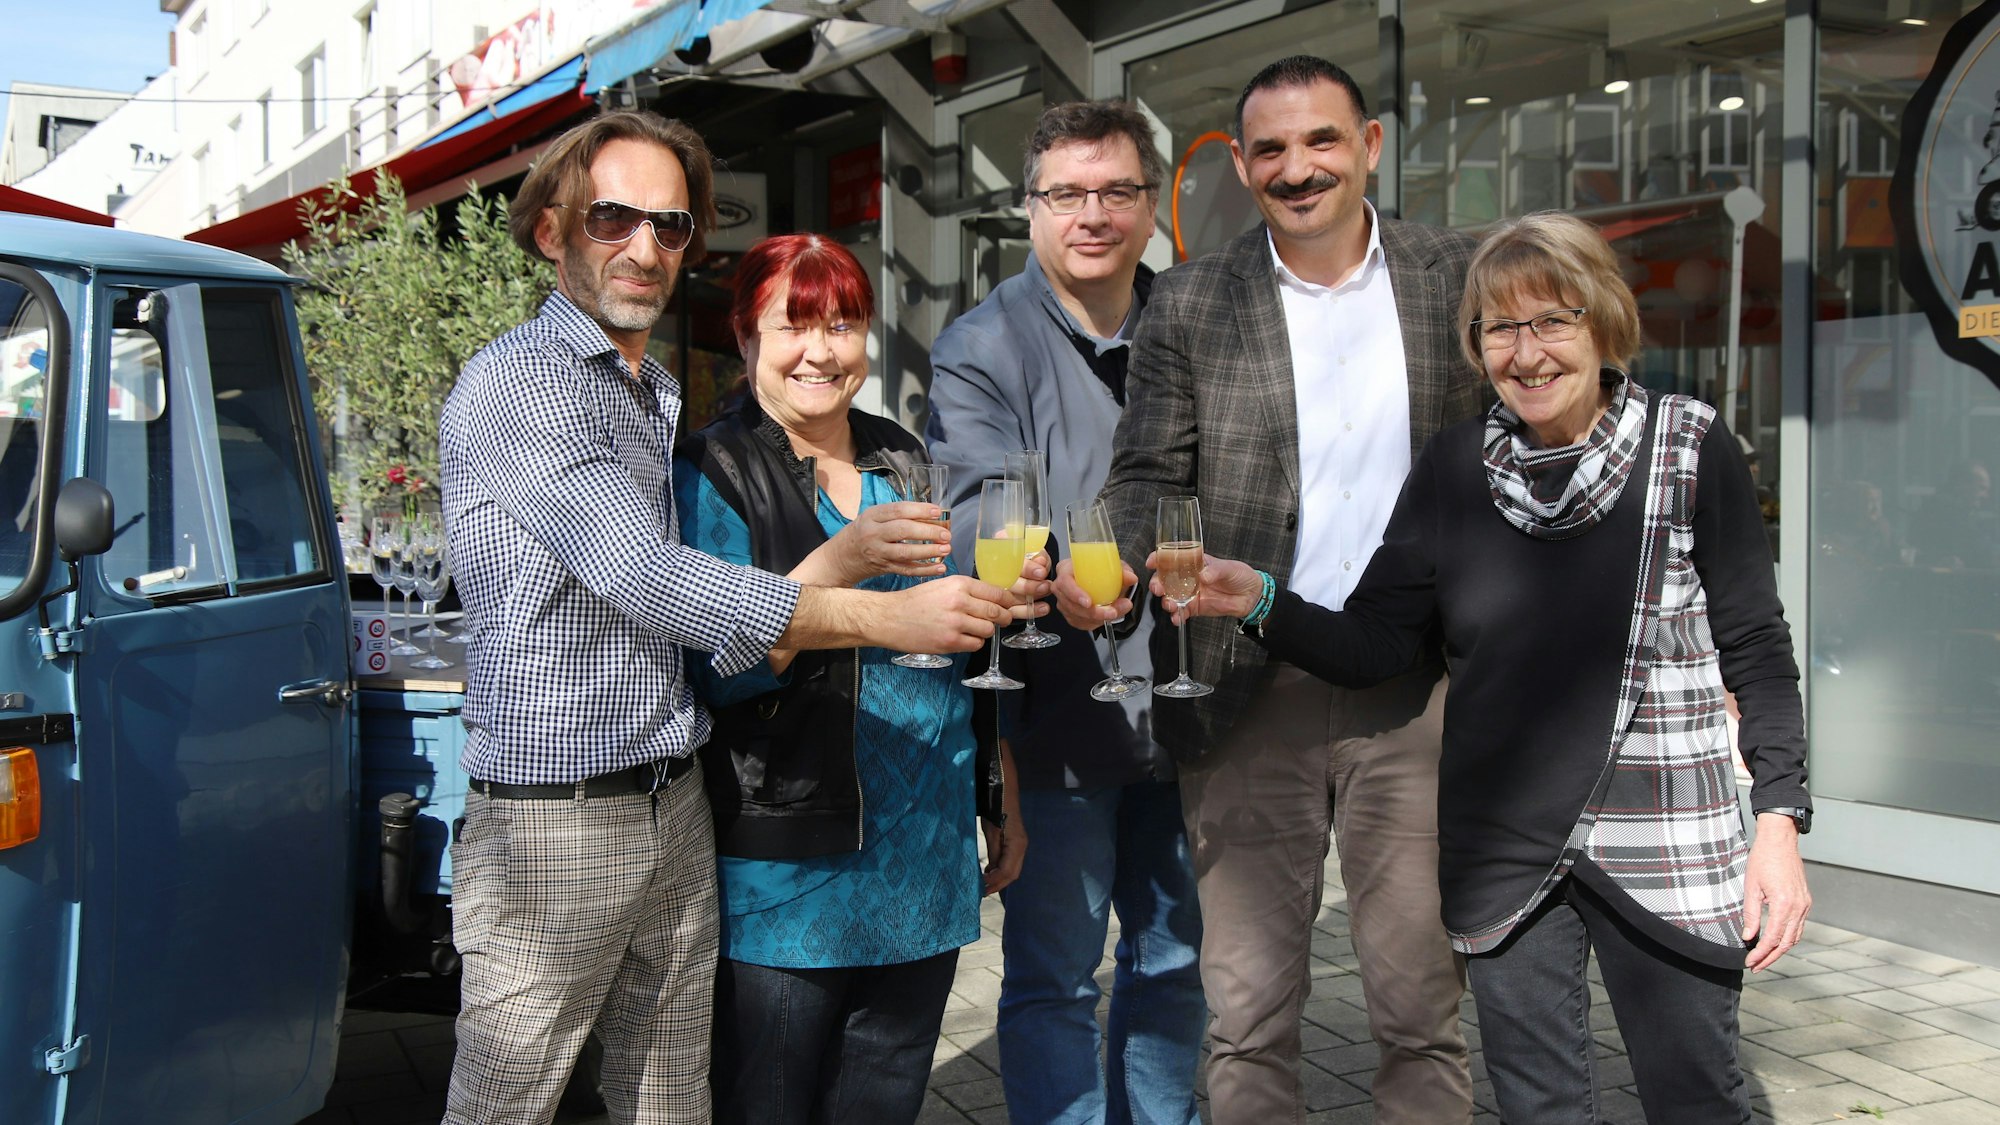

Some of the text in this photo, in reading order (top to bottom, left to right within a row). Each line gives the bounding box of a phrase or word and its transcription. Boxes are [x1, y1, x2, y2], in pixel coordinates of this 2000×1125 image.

[1965, 311, 2000, 331] DIE
[373, 624, 383, 633] 60
[373, 657, 383, 666] 60
